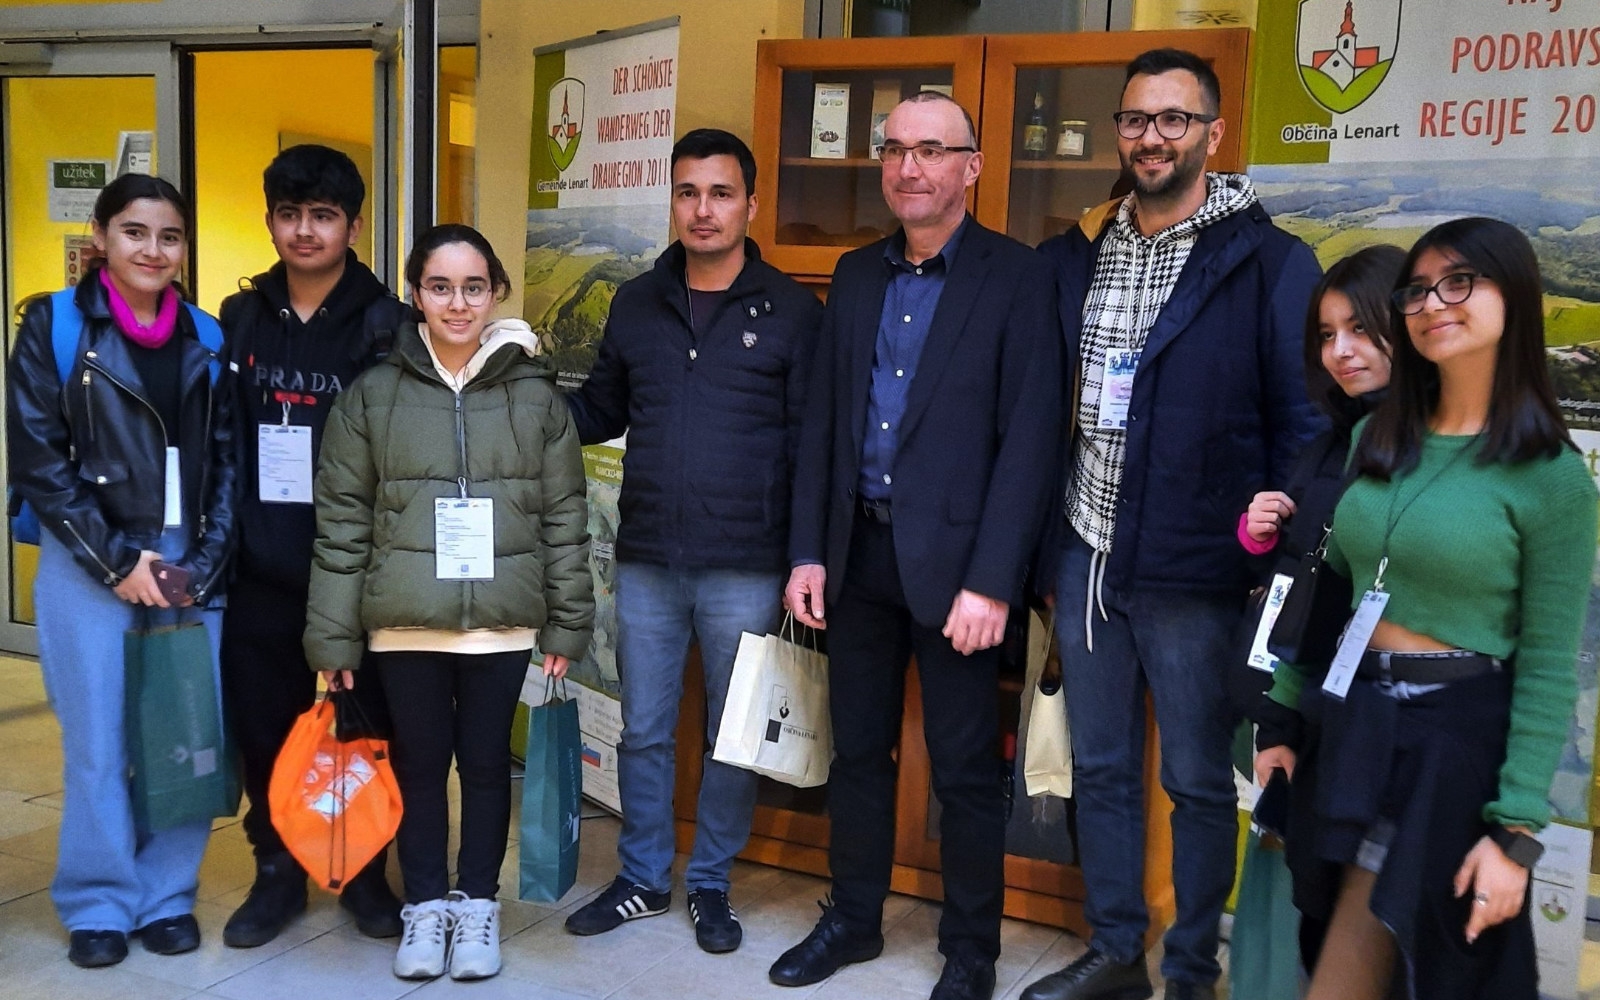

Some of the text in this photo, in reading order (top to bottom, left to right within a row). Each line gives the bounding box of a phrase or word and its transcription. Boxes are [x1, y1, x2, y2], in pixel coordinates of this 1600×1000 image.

[613, 55, 674, 96] DER SCHÖNSTE
[597, 108, 671, 144] WANDERWEG DER
[1282, 123, 1400, 141] Občina Lenart
[1419, 94, 1596, 146] REGIJE 20
[62, 163, 97, 179] užitek
[537, 177, 589, 192] Gemeinde Lenart
[592, 157, 668, 190] DRAUREGION 2011
[254, 364, 344, 394] PRADA
